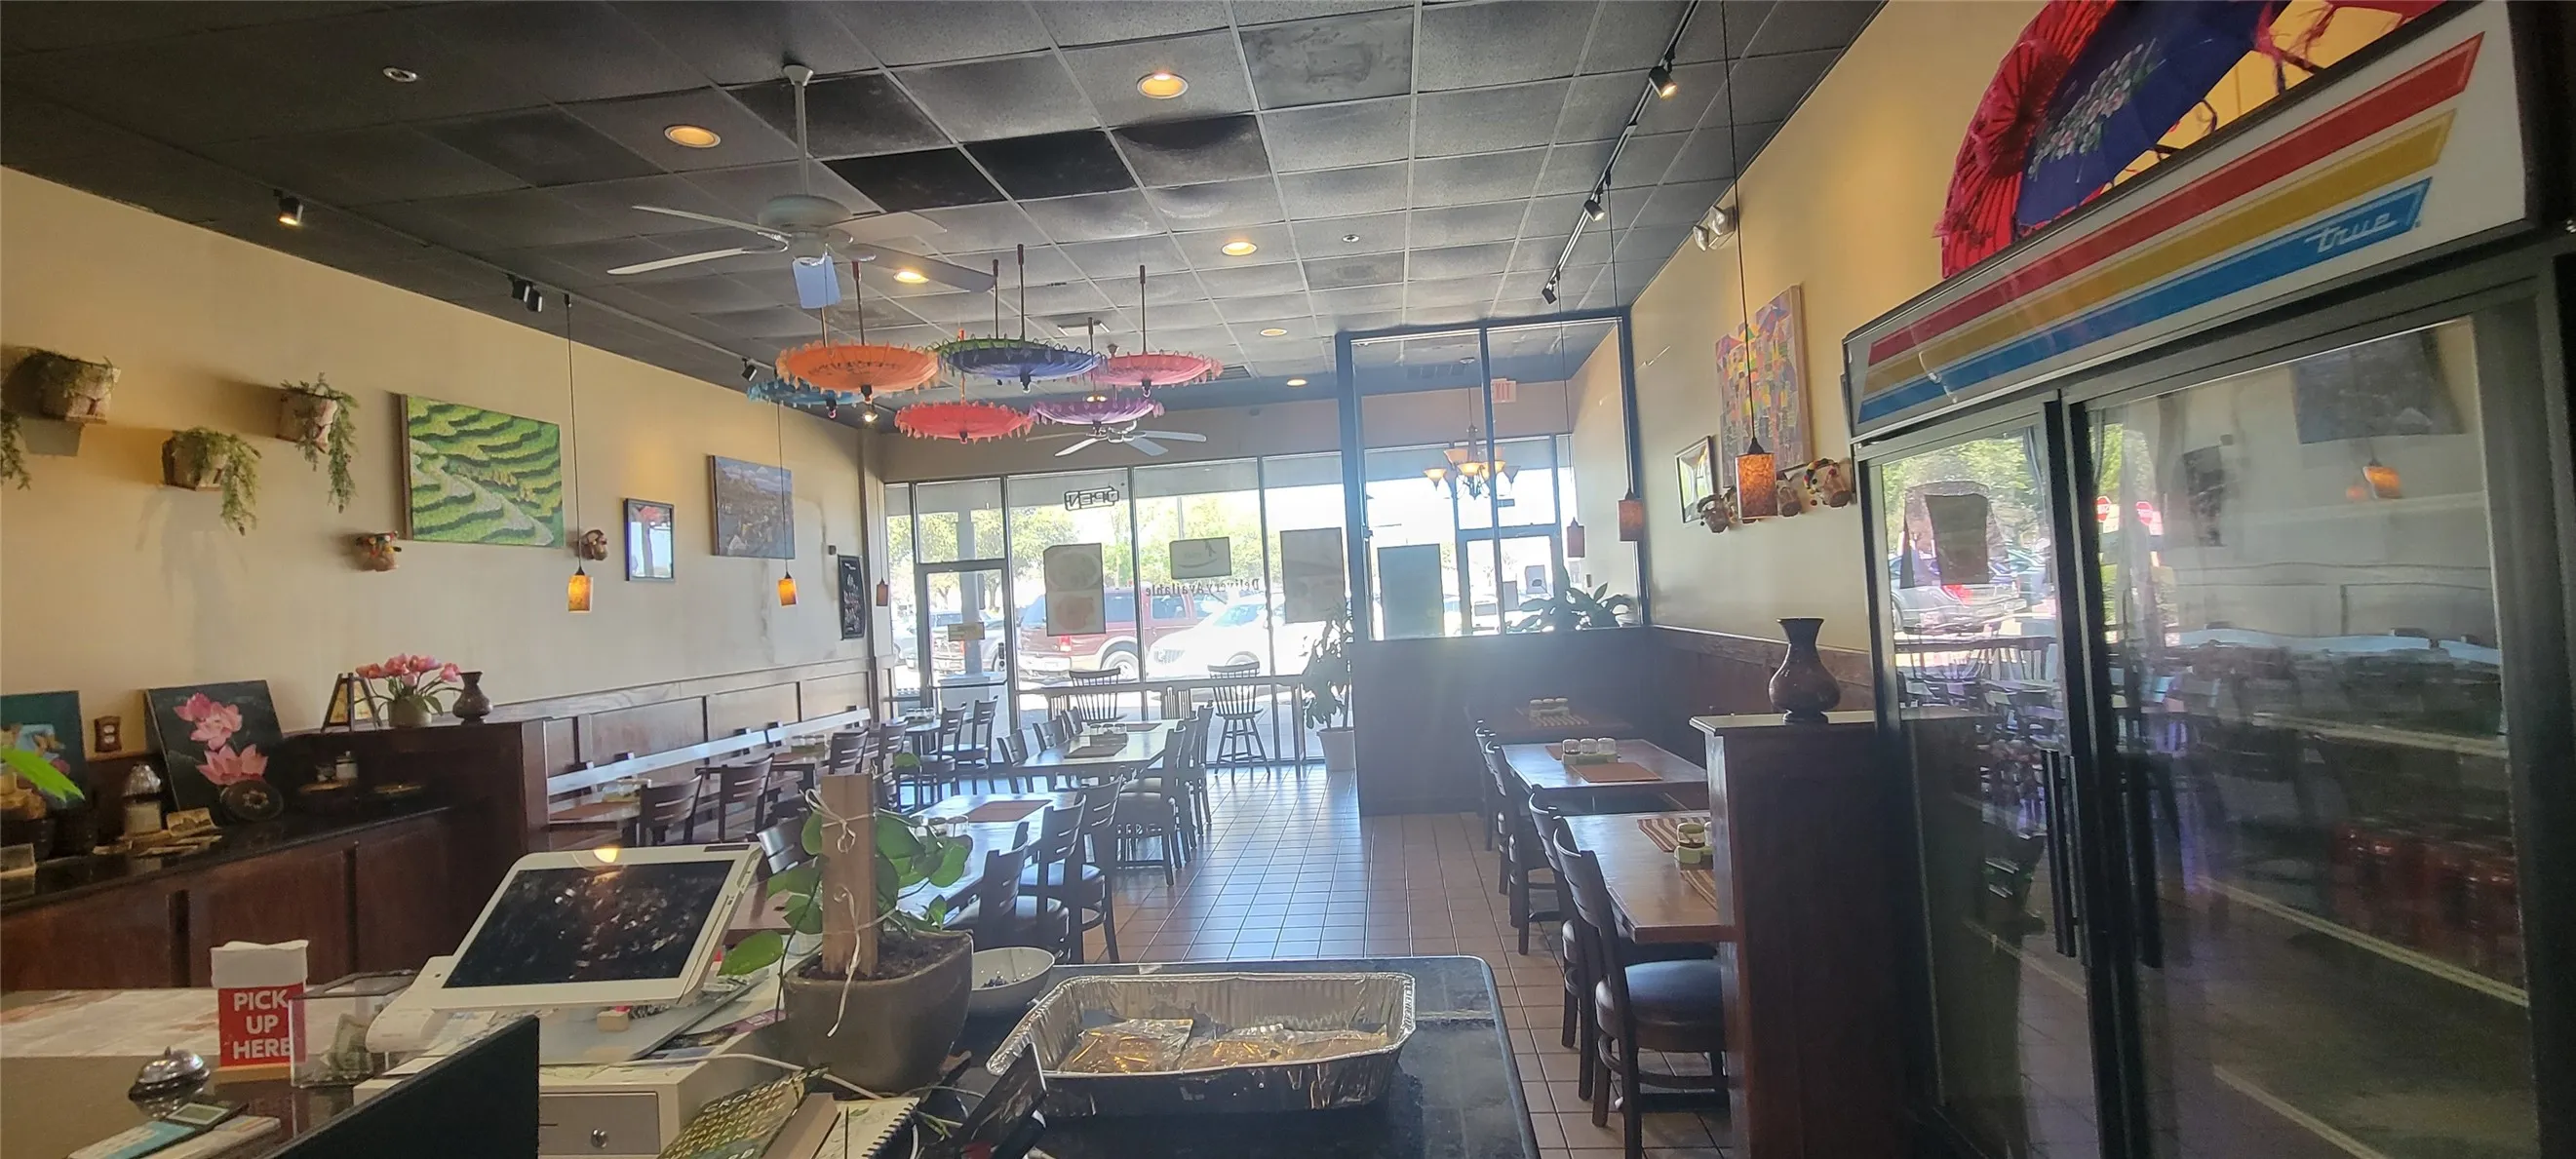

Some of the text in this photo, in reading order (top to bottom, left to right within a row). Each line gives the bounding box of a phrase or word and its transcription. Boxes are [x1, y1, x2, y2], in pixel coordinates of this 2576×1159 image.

[234, 989, 289, 1011] PICK
[246, 1015, 279, 1033] UP
[233, 1037, 292, 1060] HERE
[703, 1068, 821, 1113] CROSSINGS
